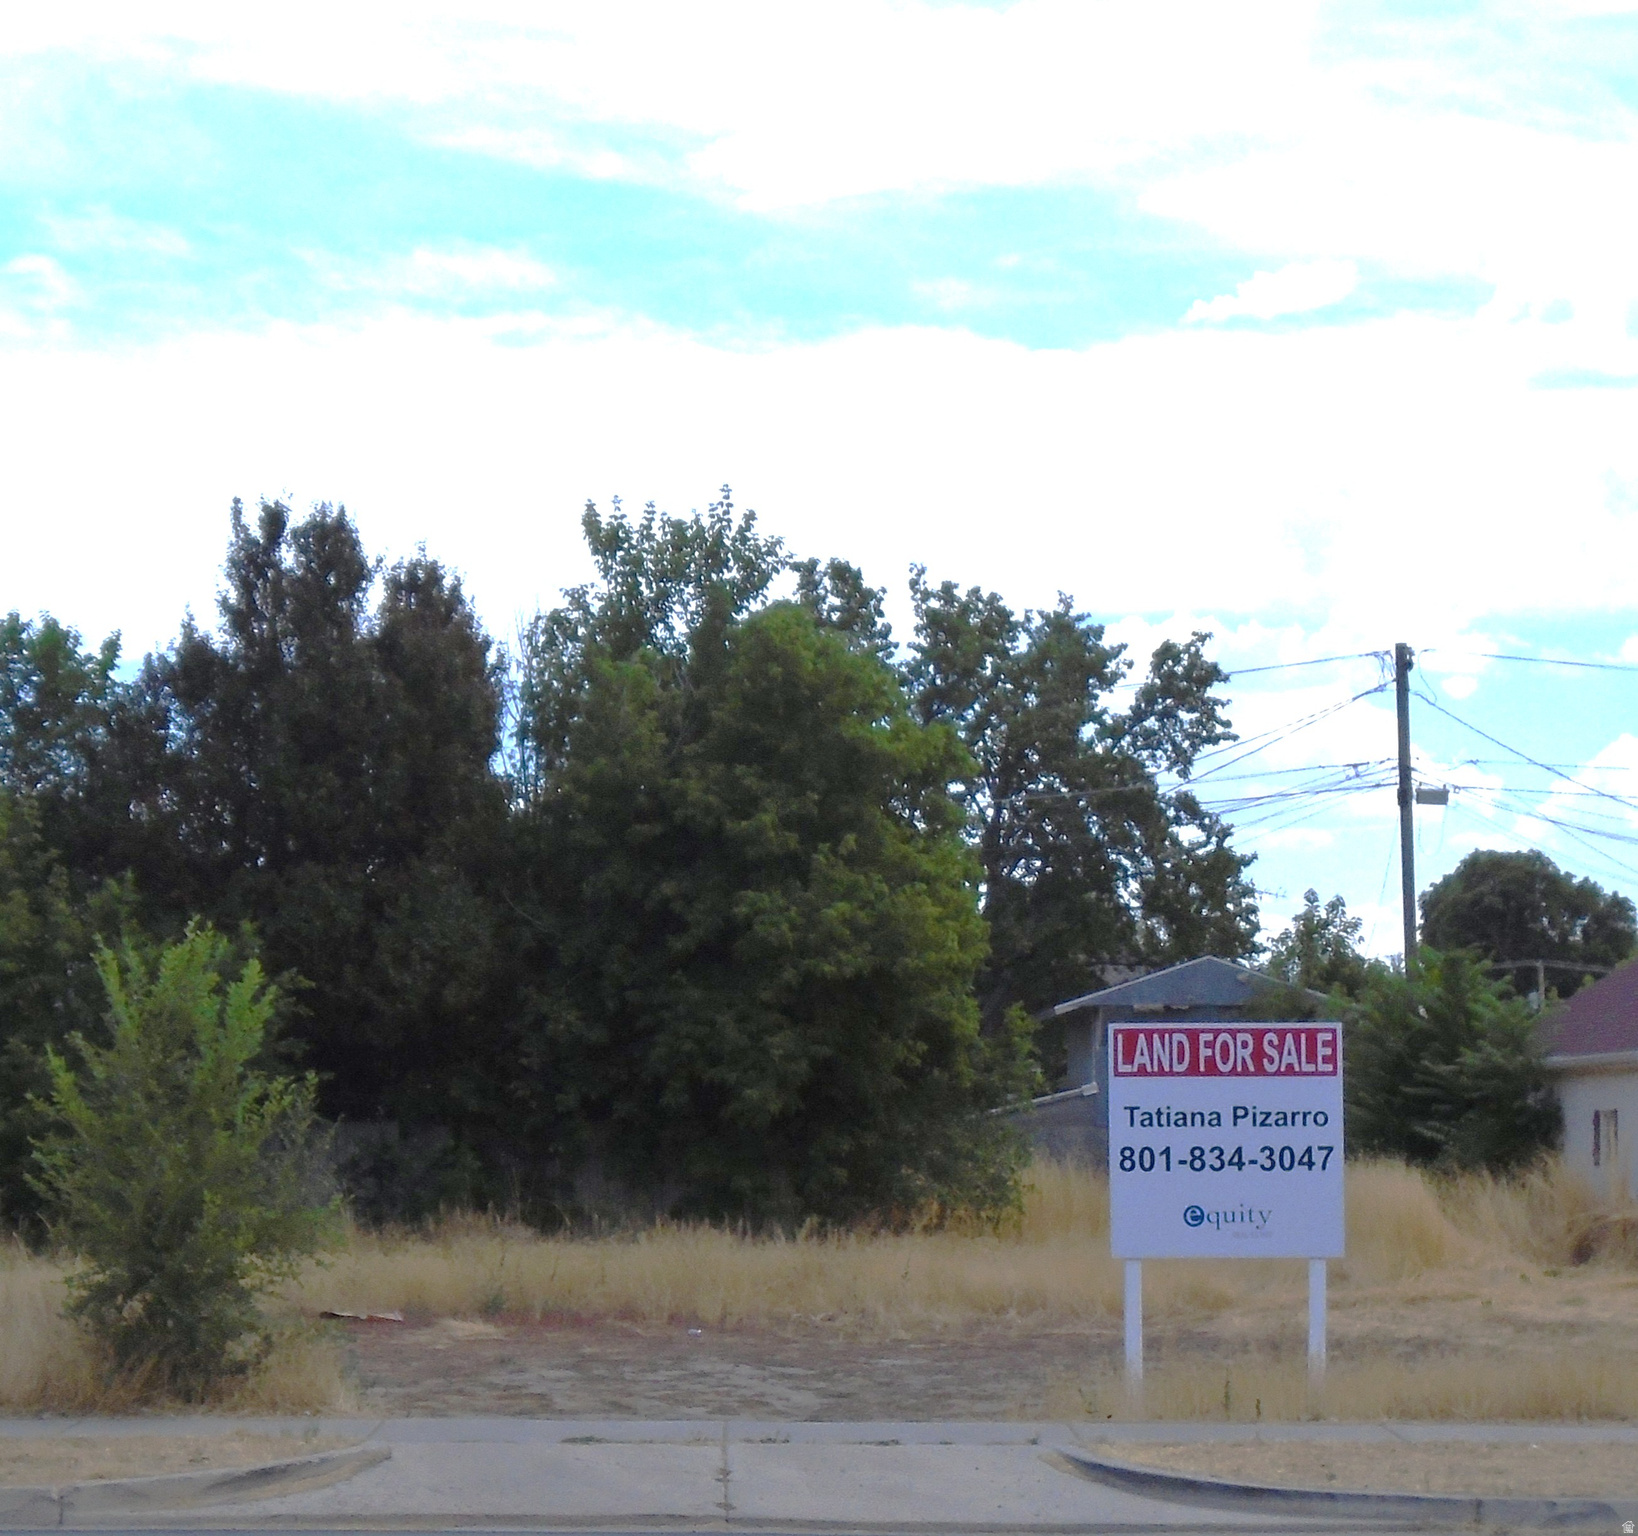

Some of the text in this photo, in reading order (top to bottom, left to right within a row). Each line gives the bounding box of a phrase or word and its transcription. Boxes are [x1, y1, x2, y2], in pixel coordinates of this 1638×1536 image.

[1116, 1032, 1333, 1073] LAND FOR SALE
[1123, 1104, 1329, 1128] Tatiana Pizarro
[1118, 1144, 1335, 1173] 801-834-3047
[1183, 1203, 1273, 1231] equity
